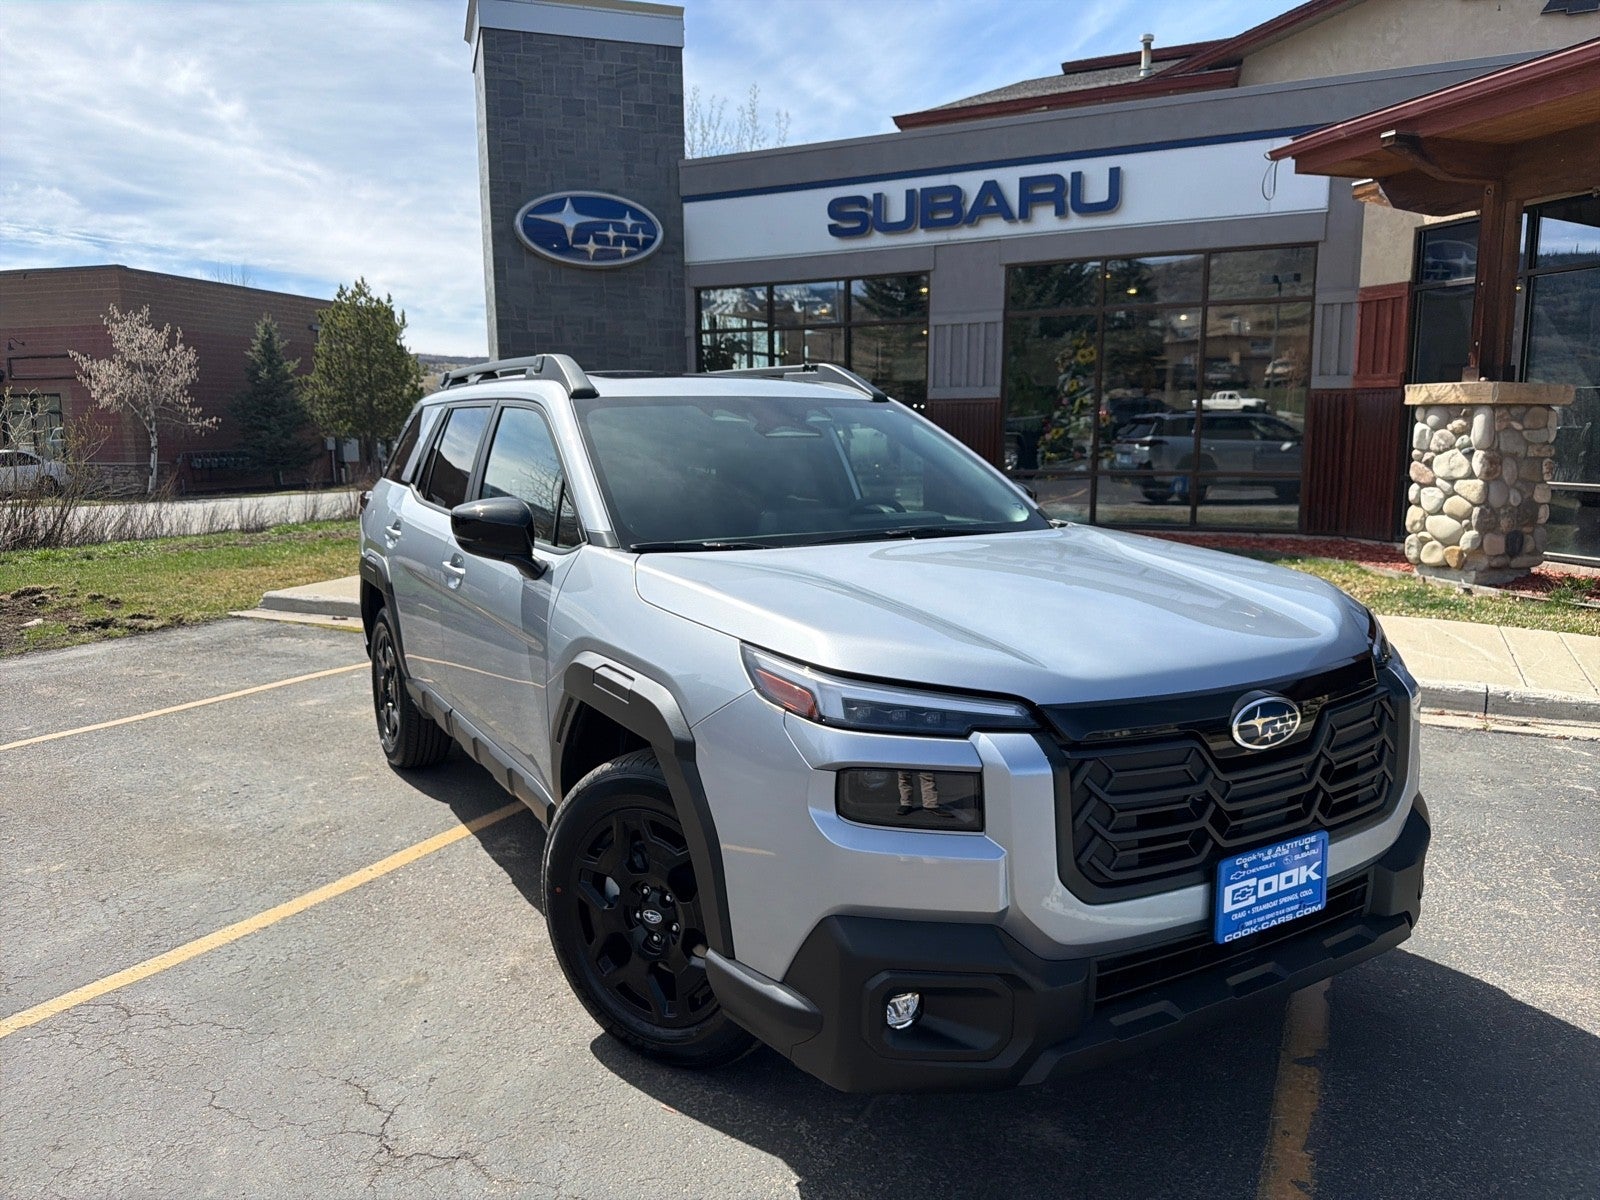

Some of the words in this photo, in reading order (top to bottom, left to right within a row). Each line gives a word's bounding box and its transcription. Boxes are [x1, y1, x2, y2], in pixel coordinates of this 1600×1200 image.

[827, 166, 1121, 237] SUBARU
[1275, 835, 1317, 853] ALTITUDE
[1294, 848, 1319, 861] SUBARU
[1246, 862, 1276, 875] CHEVROLET
[1223, 860, 1322, 914] COOK
[1231, 910, 1247, 921] CRAIG
[1251, 900, 1278, 914] STEAMBOAT
